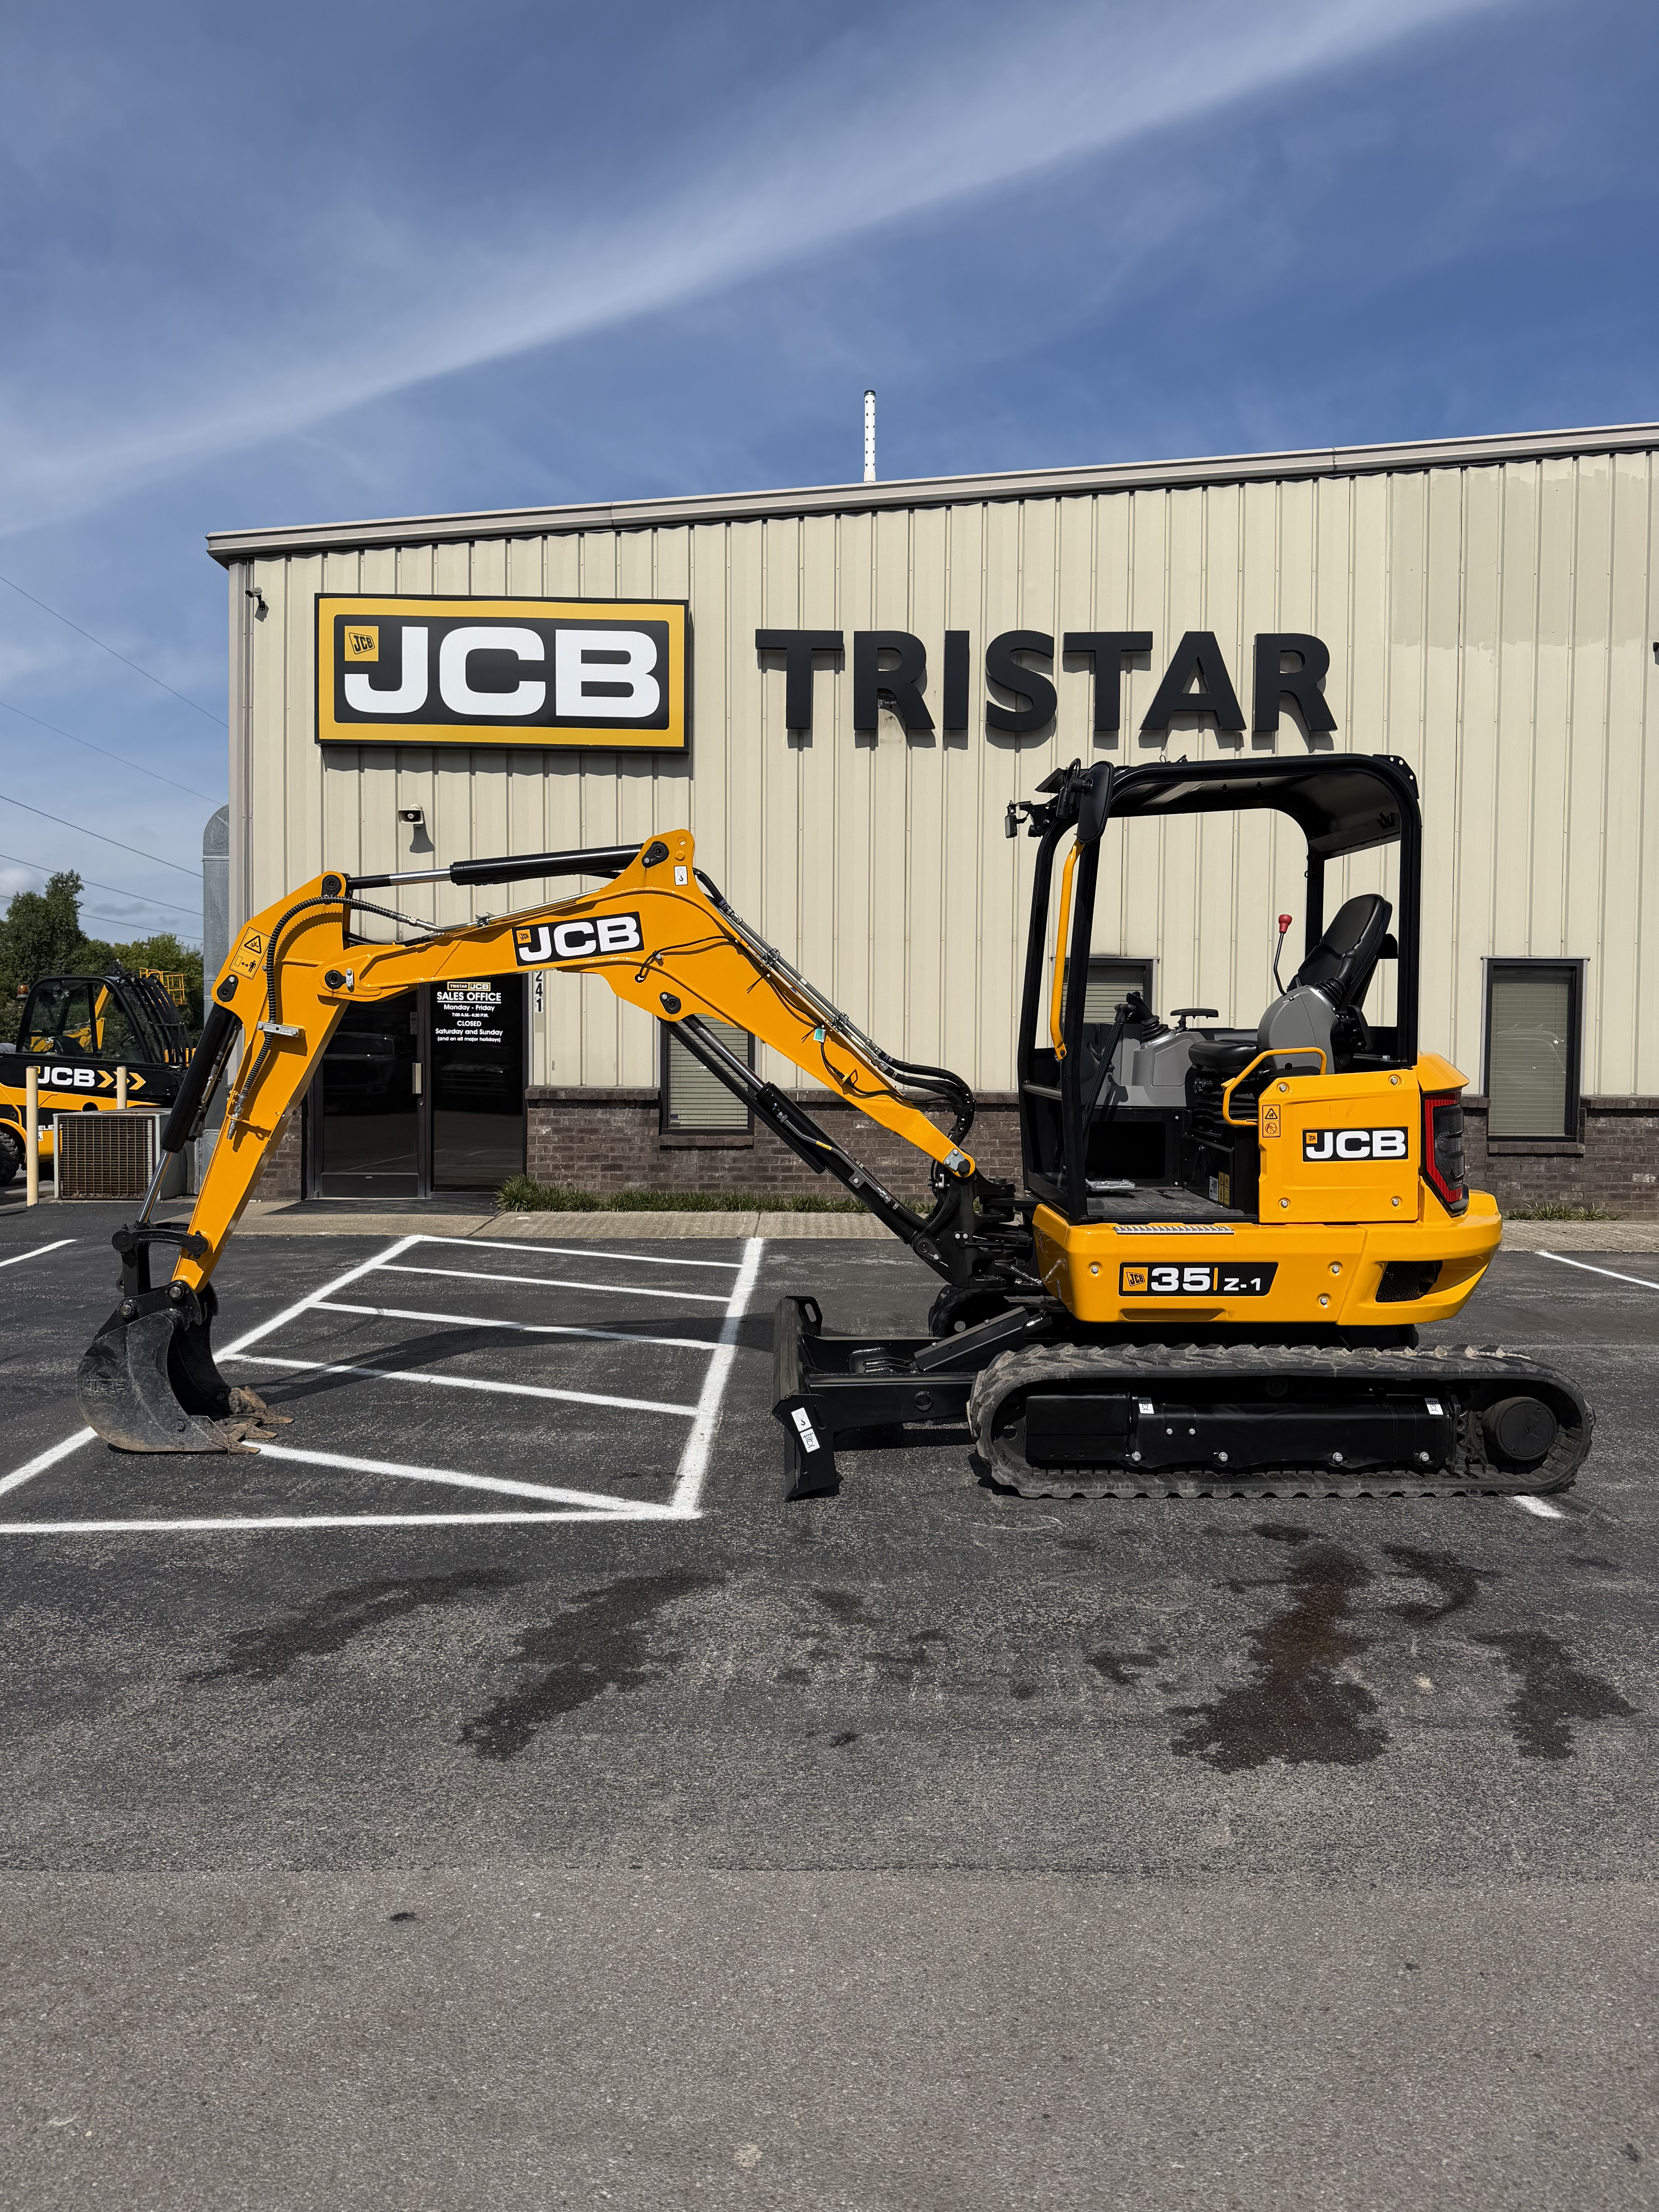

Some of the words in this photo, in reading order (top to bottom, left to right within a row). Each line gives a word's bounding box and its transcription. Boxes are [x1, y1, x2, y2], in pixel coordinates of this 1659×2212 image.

[353, 635, 373, 652] JCB
[345, 626, 660, 717] JCB
[756, 629, 1338, 732] TRISTAR
[519, 916, 640, 962] JCB
[437, 992, 464, 1001] SALES
[467, 992, 501, 1001] OFFICE
[38, 1066, 95, 1087] JCB
[1306, 1130, 1406, 1159] JCB
[1129, 1273, 1144, 1285] JCB
[1151, 1267, 1210, 1291] 35
[1223, 1278, 1261, 1291] Z-1
